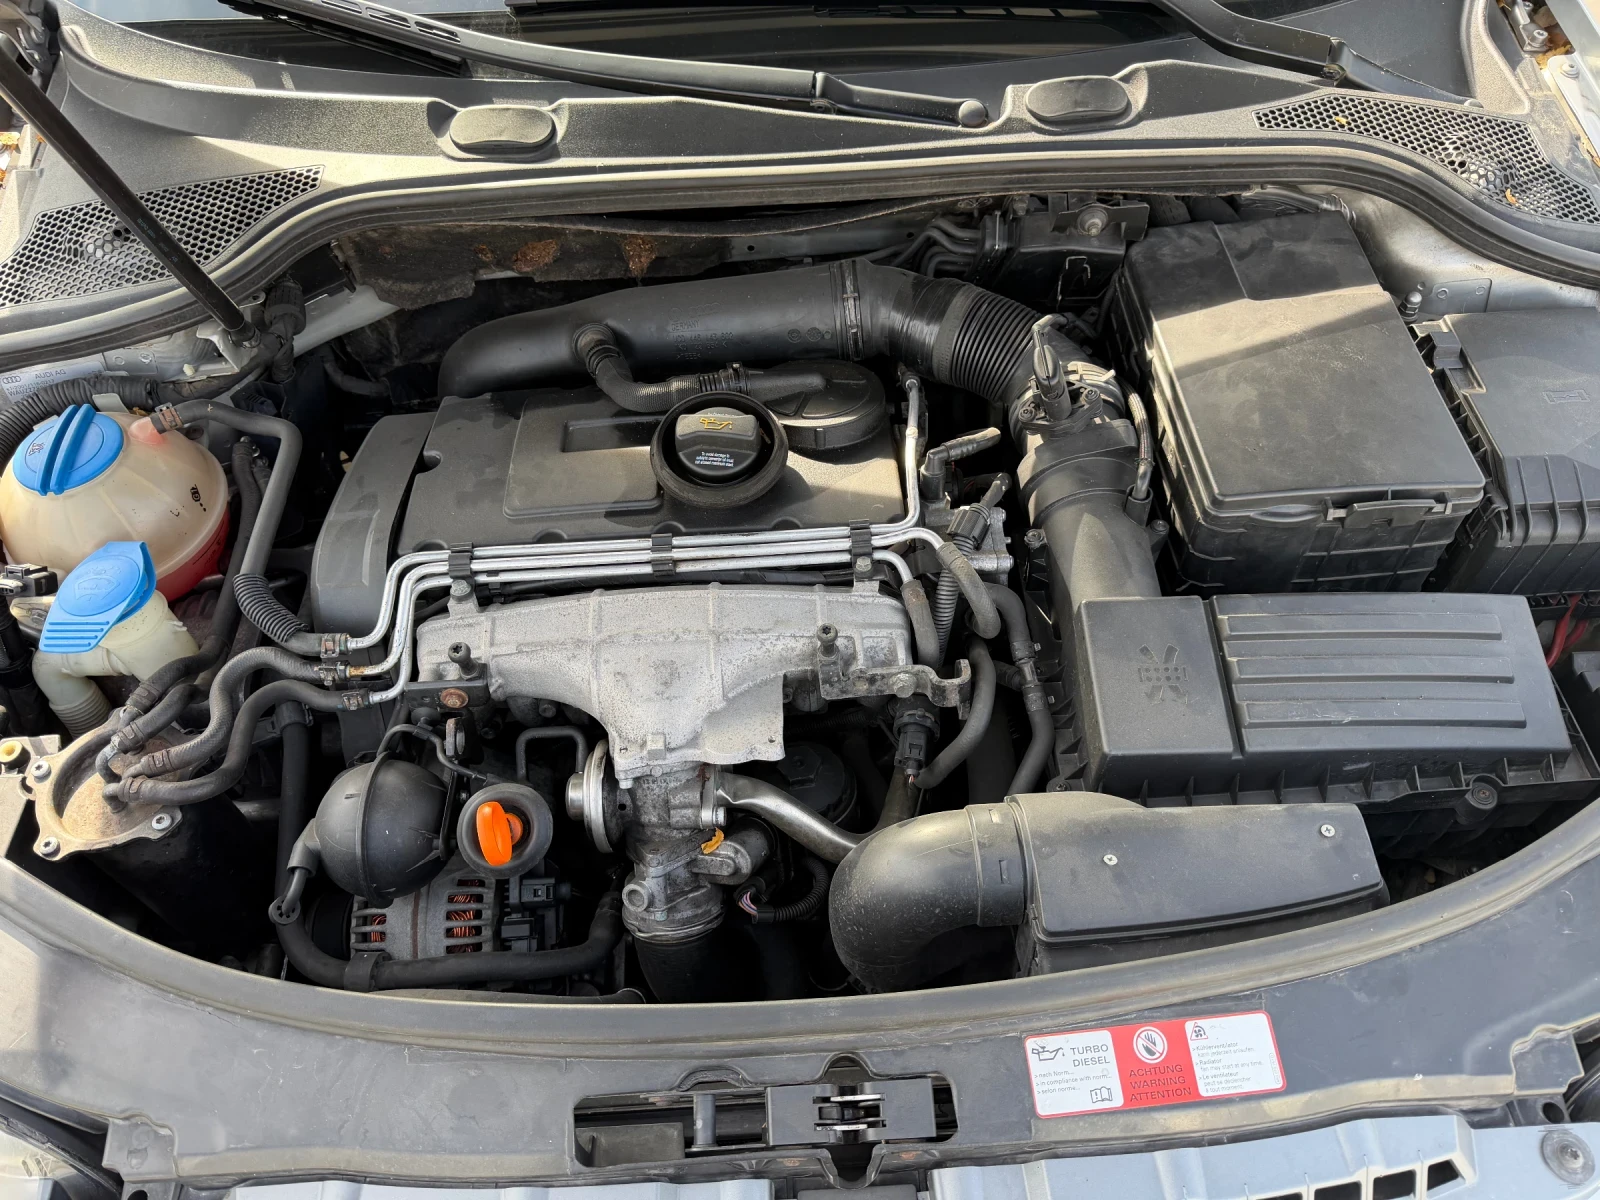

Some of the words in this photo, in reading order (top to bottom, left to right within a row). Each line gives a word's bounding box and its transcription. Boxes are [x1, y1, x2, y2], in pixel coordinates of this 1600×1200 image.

[35, 371, 54, 379] AUDI
[1070, 1044, 1109, 1055] TURBO
[1072, 1056, 1110, 1067] DIESEL
[1129, 1064, 1183, 1078] ACHTUNG
[1130, 1075, 1186, 1090] WARNING
[1130, 1087, 1192, 1102] ATTENTION
